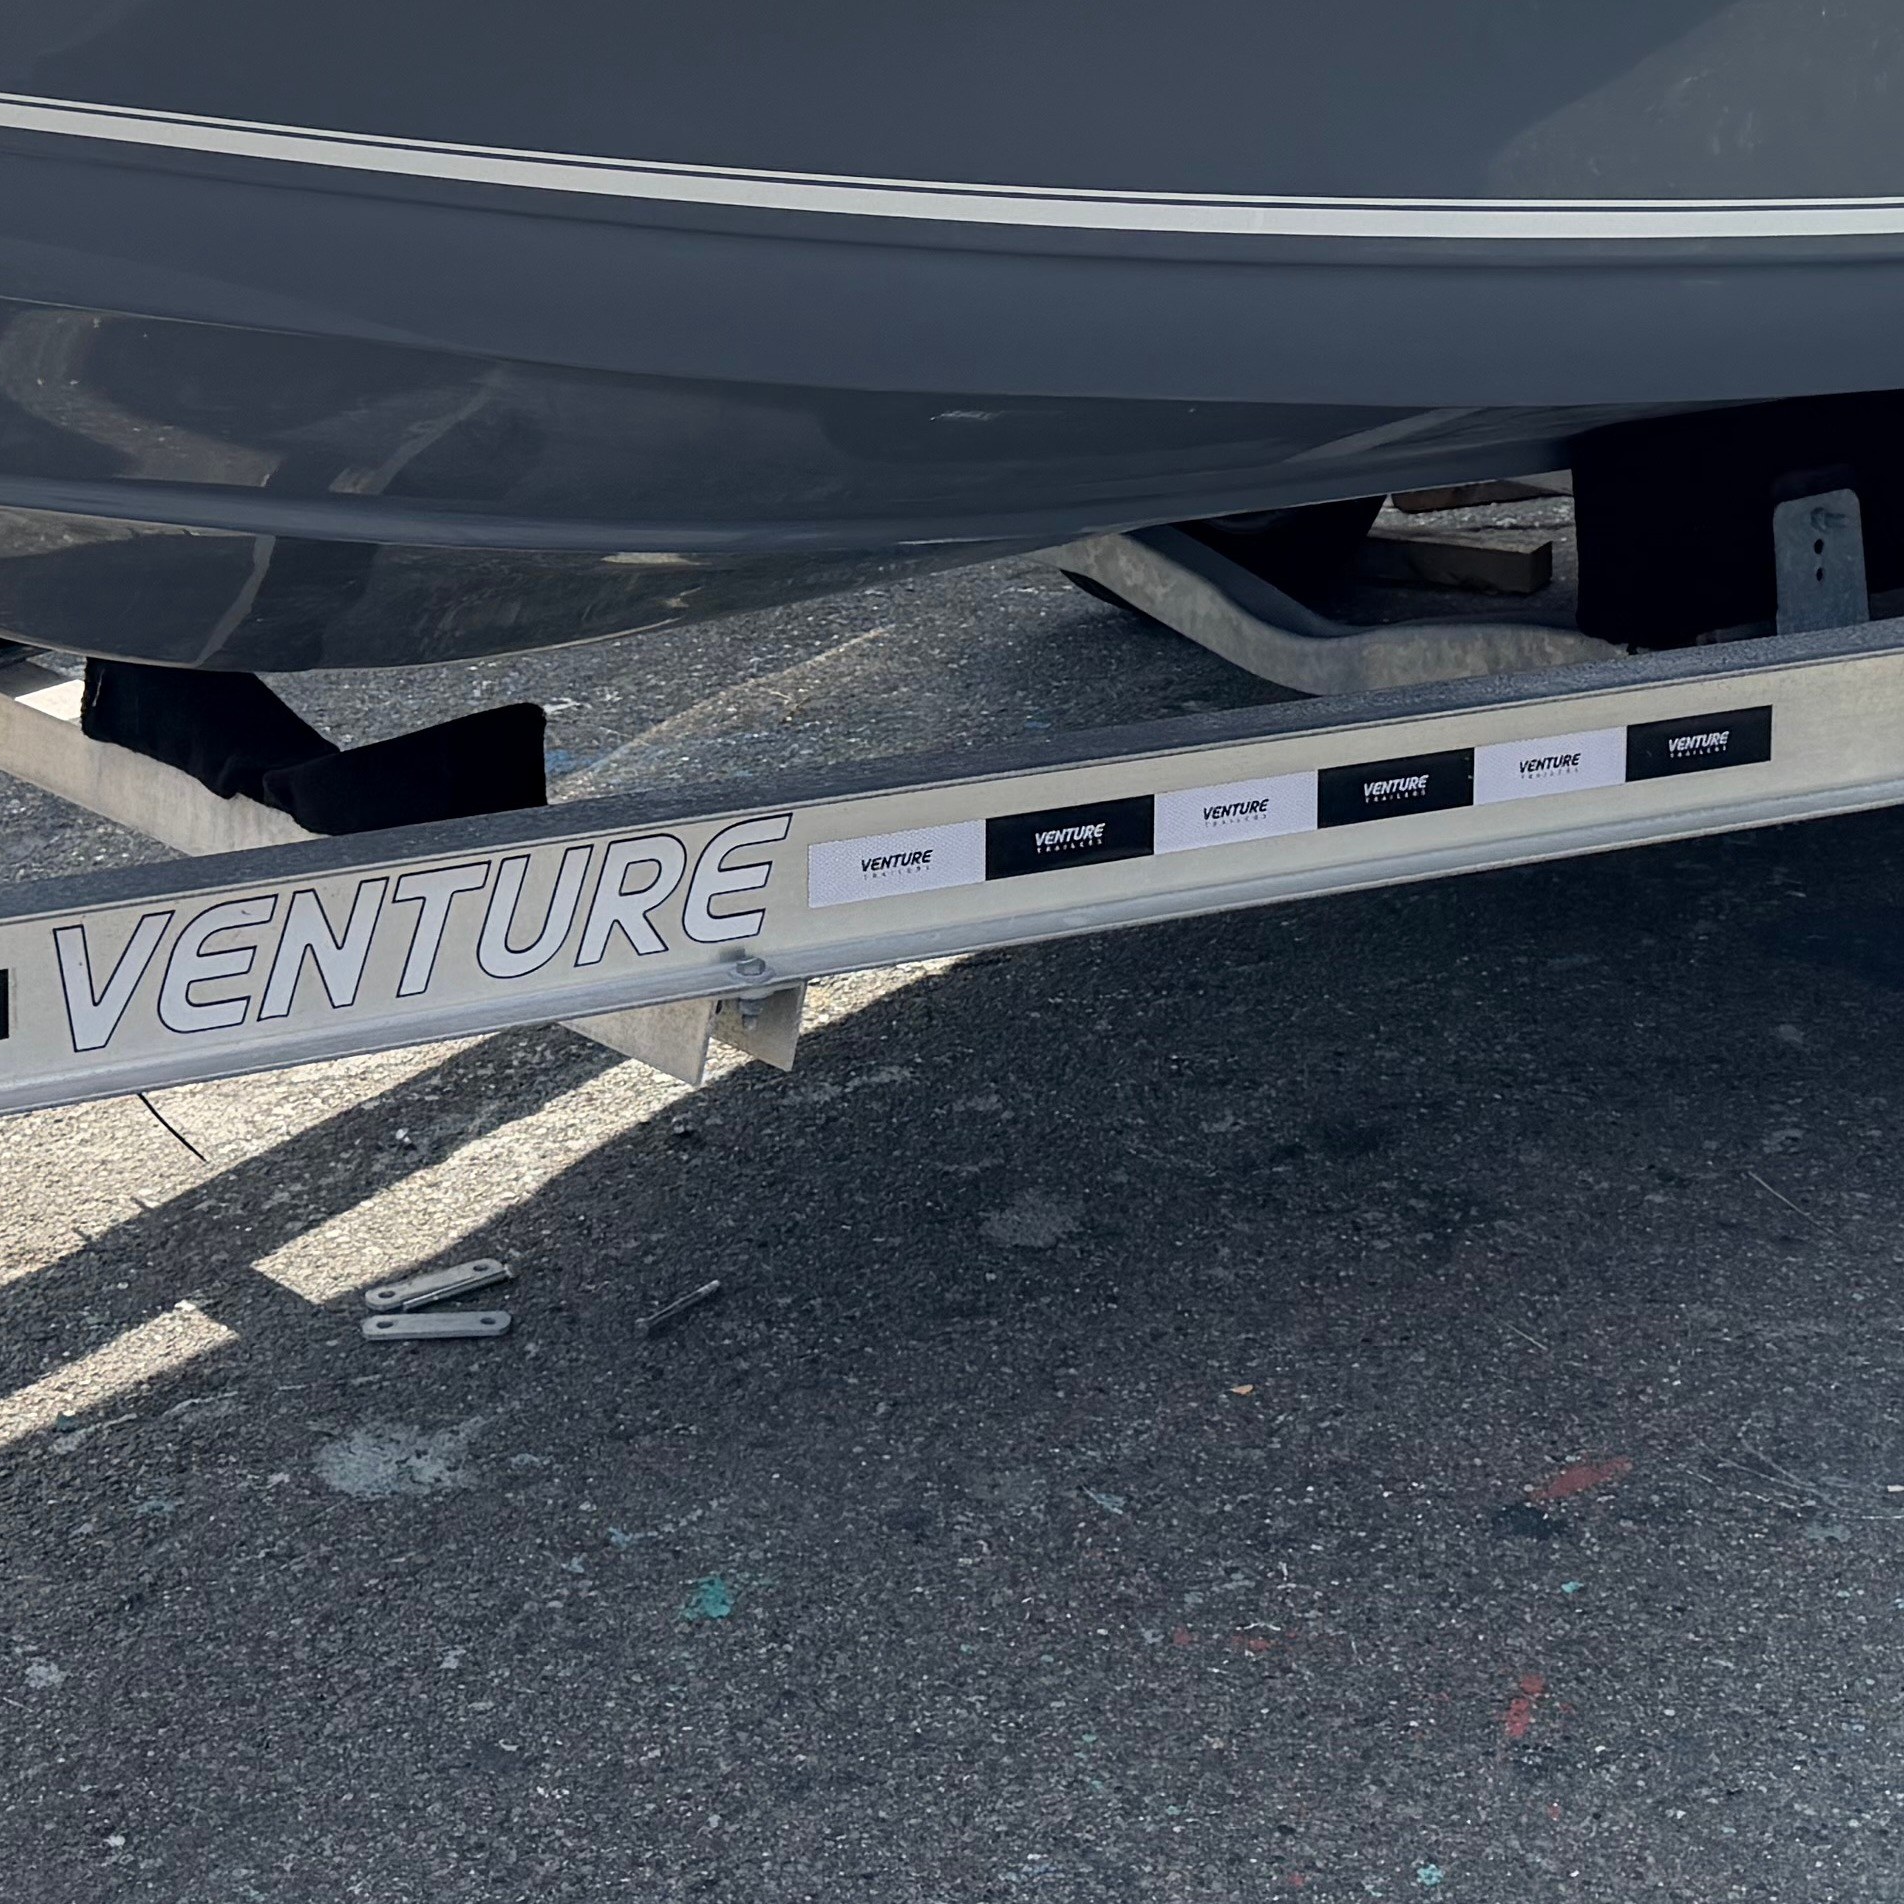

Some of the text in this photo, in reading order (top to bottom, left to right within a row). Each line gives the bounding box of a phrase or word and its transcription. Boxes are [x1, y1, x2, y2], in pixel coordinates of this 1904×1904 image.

[1668, 730, 1730, 753] VENTURE
[1519, 752, 1582, 774] VENTURE
[1363, 774, 1430, 797] VENTURE
[1203, 798, 1270, 821] VENTURE
[1035, 822, 1106, 846] VENTURE
[861, 849, 934, 872] VENTURE
[53, 812, 794, 1053] VENTURE
